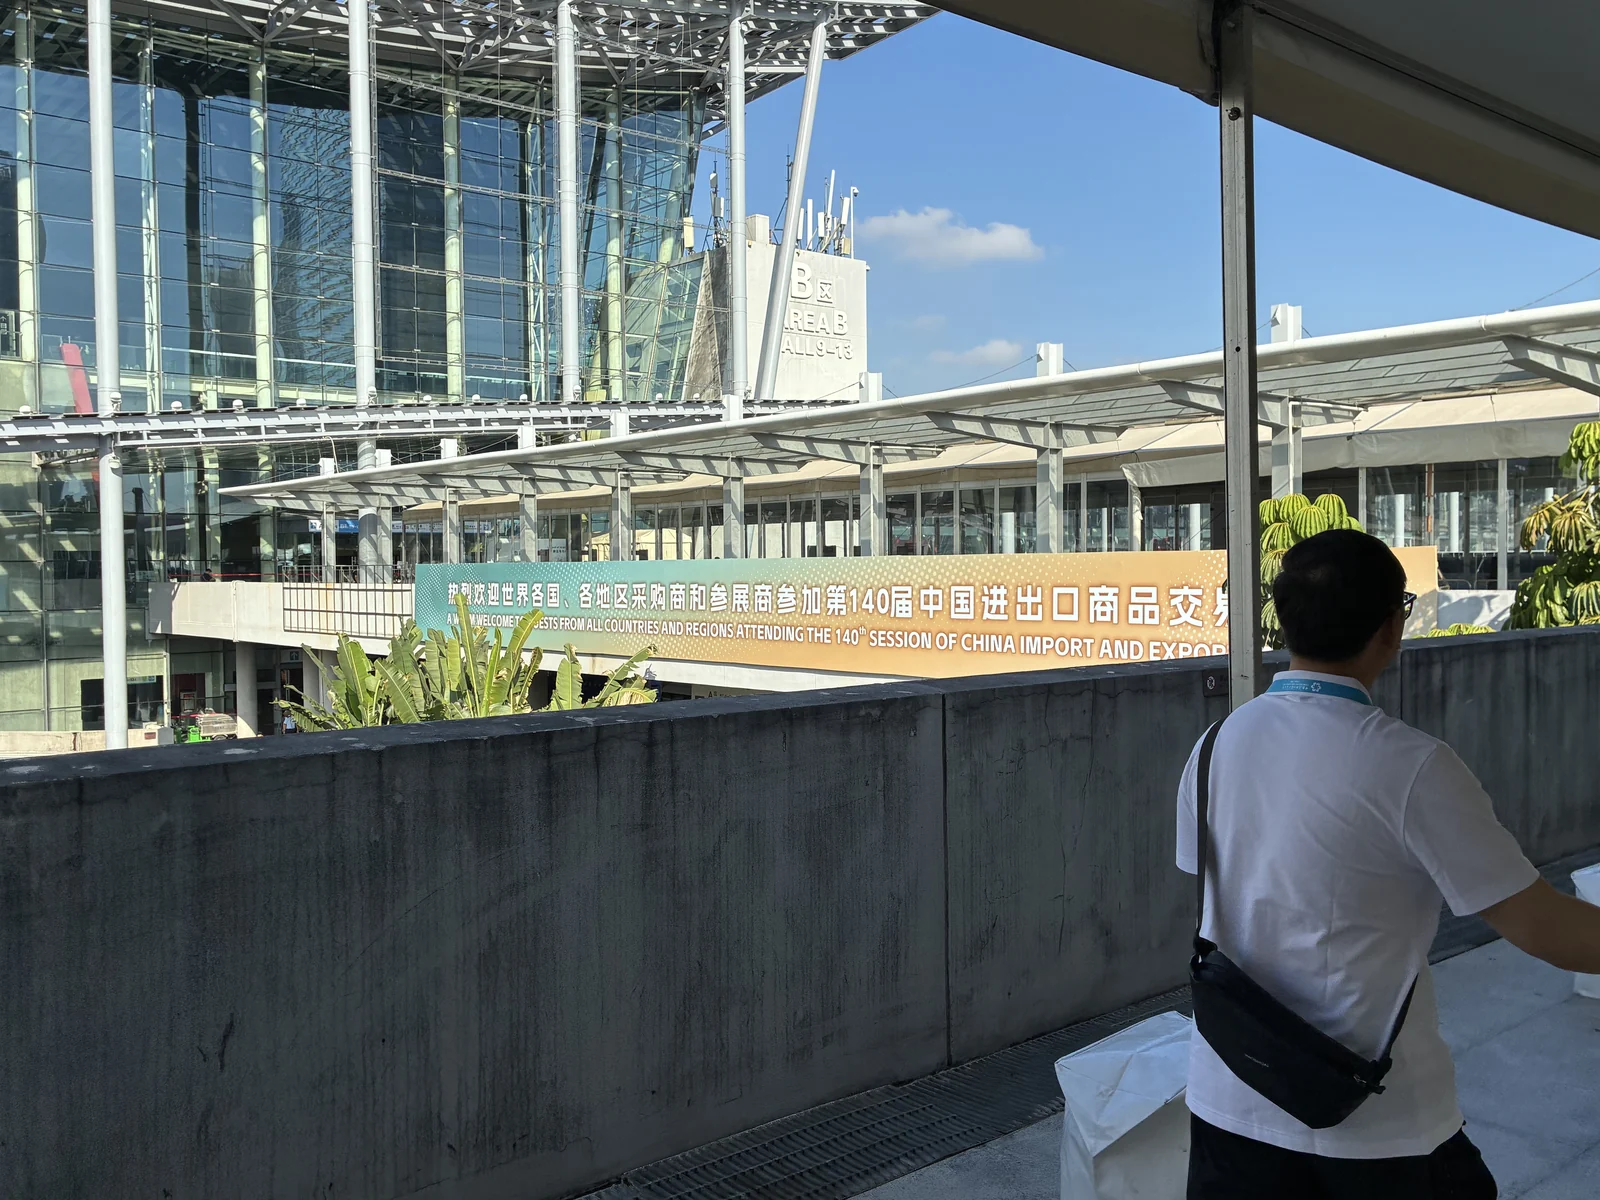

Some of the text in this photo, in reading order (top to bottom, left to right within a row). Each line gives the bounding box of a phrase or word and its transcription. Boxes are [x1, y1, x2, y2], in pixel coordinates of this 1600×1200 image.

[833, 309, 848, 336] B
[781, 334, 814, 356] ALL
[476, 614, 514, 627] WELCOME
[560, 617, 585, 630] FROM
[586, 619, 603, 631] ALL
[604, 619, 659, 634] COUNTRIES
[661, 621, 684, 635] AND
[685, 622, 734, 638] REGIONS
[736, 624, 804, 642] ATTENDING
[806, 627, 832, 643] THE
[869, 630, 932, 649] SESSION
[935, 633, 957, 650] OF
[961, 634, 1016, 653] CHINA
[1020, 635, 1095, 657] IMPORT
[1098, 639, 1144, 660] AND
[1149, 641, 1228, 660] EXPOR
